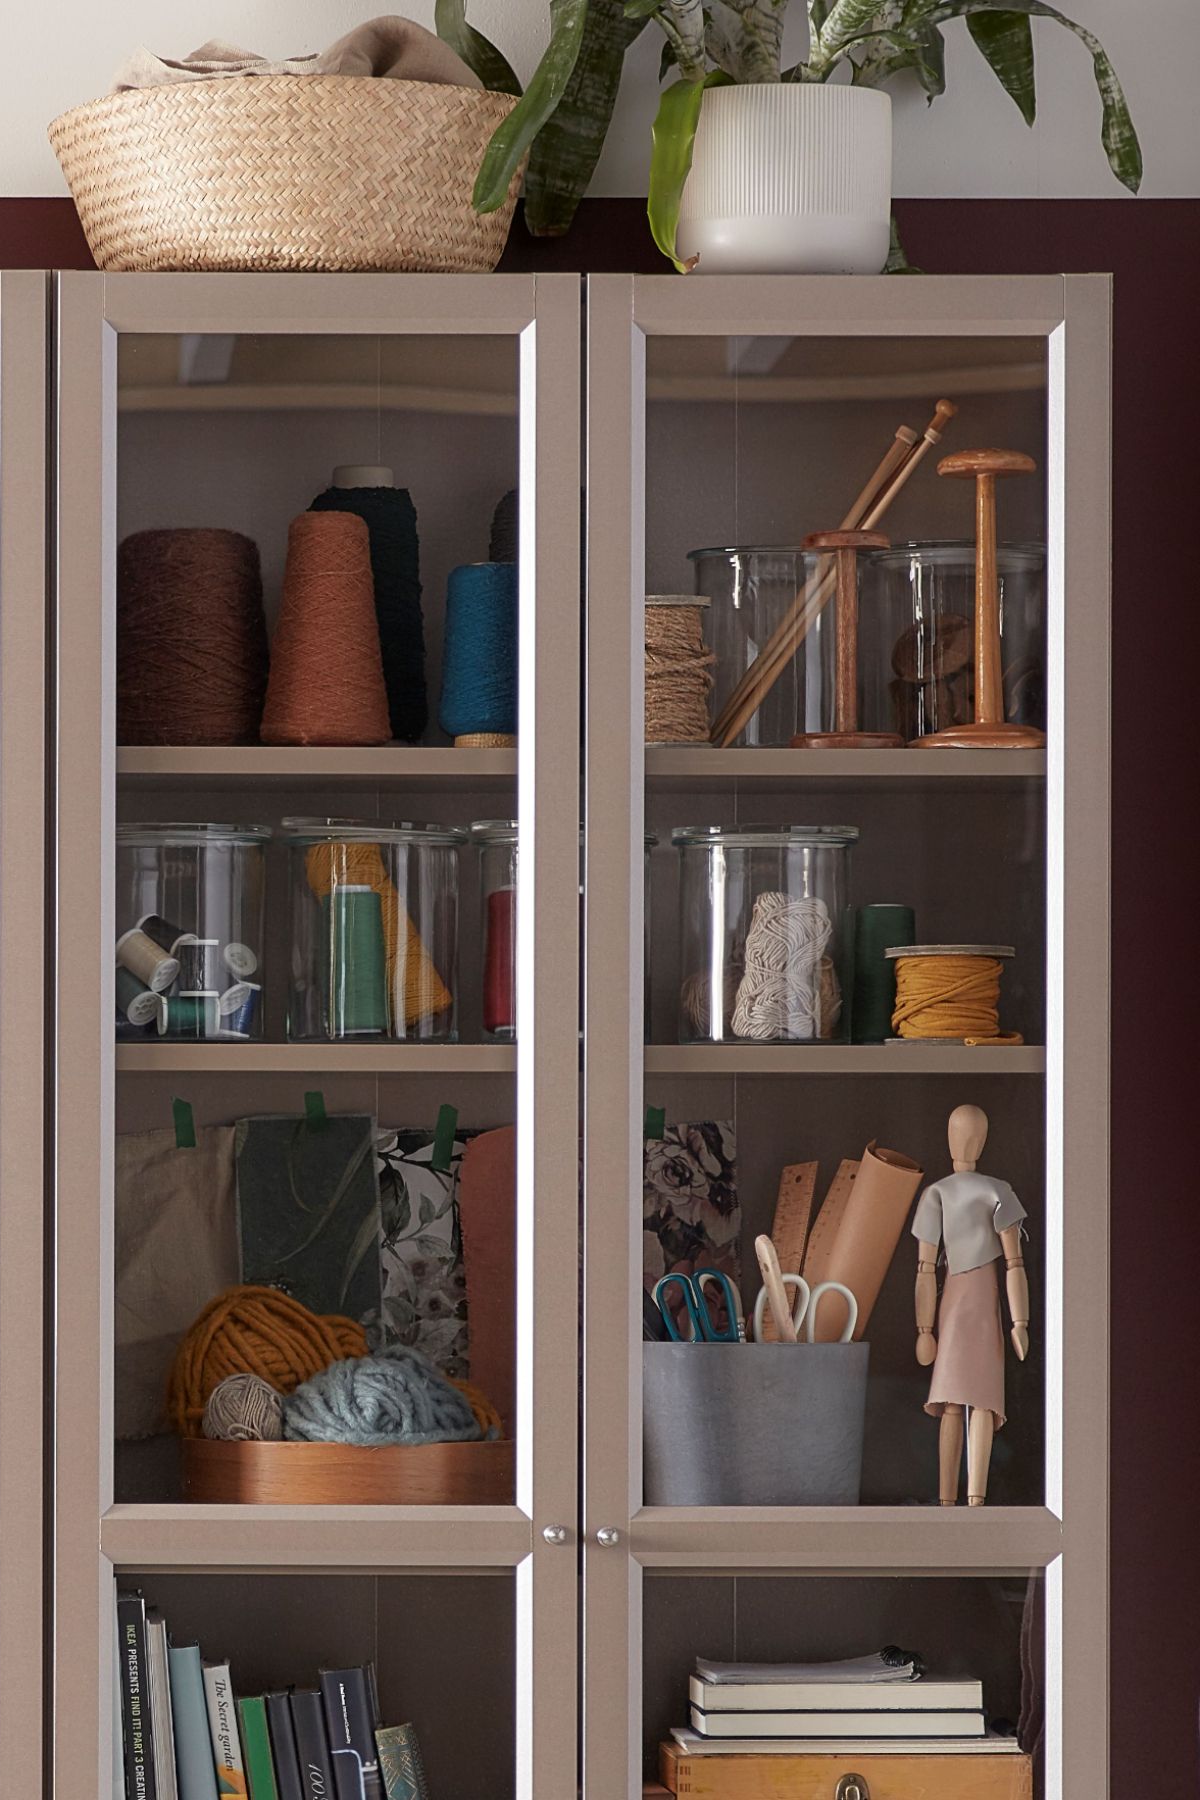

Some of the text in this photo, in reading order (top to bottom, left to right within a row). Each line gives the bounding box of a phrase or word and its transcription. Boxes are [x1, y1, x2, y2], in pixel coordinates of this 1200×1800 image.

[126, 1624, 137, 1645] IKEA
[128, 1649, 140, 1694] PRESENTS
[131, 1696, 141, 1716] FIND
[132, 1718, 142, 1730] IT!
[214, 1680, 236, 1771] The Secret garden
[133, 1732, 144, 1755] PART
